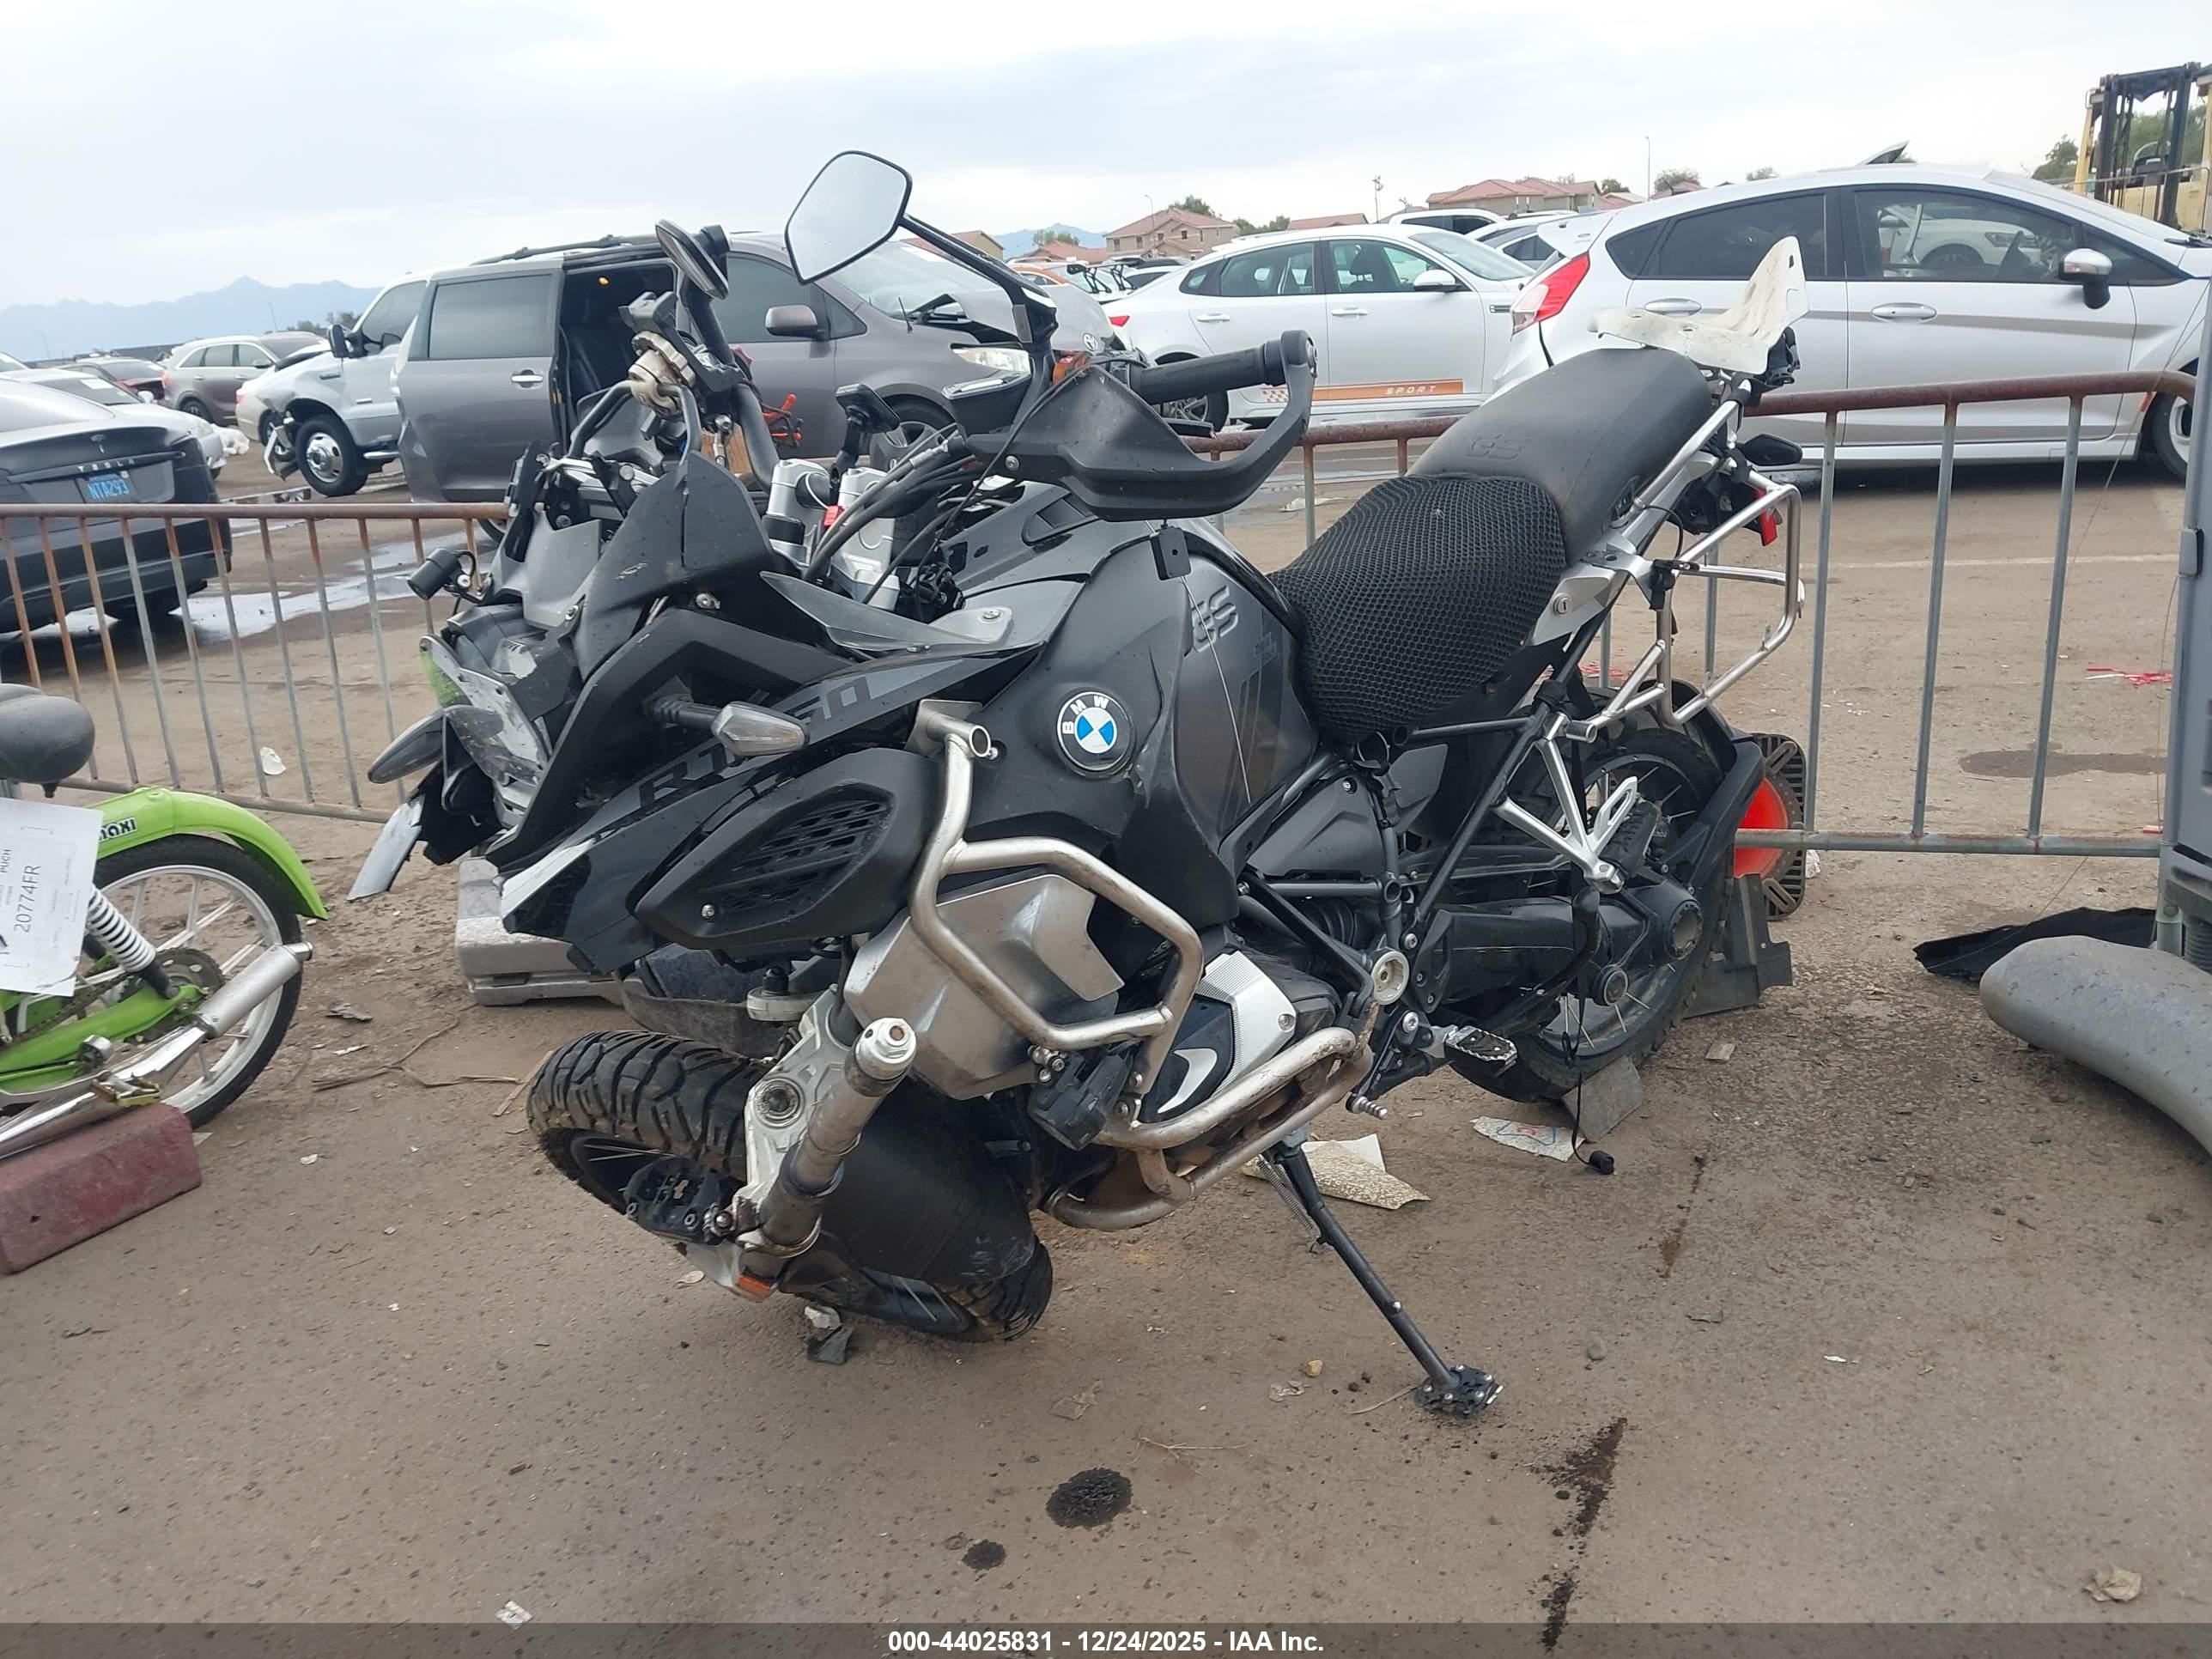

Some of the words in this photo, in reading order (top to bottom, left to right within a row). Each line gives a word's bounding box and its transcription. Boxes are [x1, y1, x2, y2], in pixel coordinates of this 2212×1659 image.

[1384, 385, 1437, 395] SPORT
[77, 458, 135, 472] TESLA
[1061, 694, 1109, 735] BMW
[14, 865, 41, 933] 20774FR
